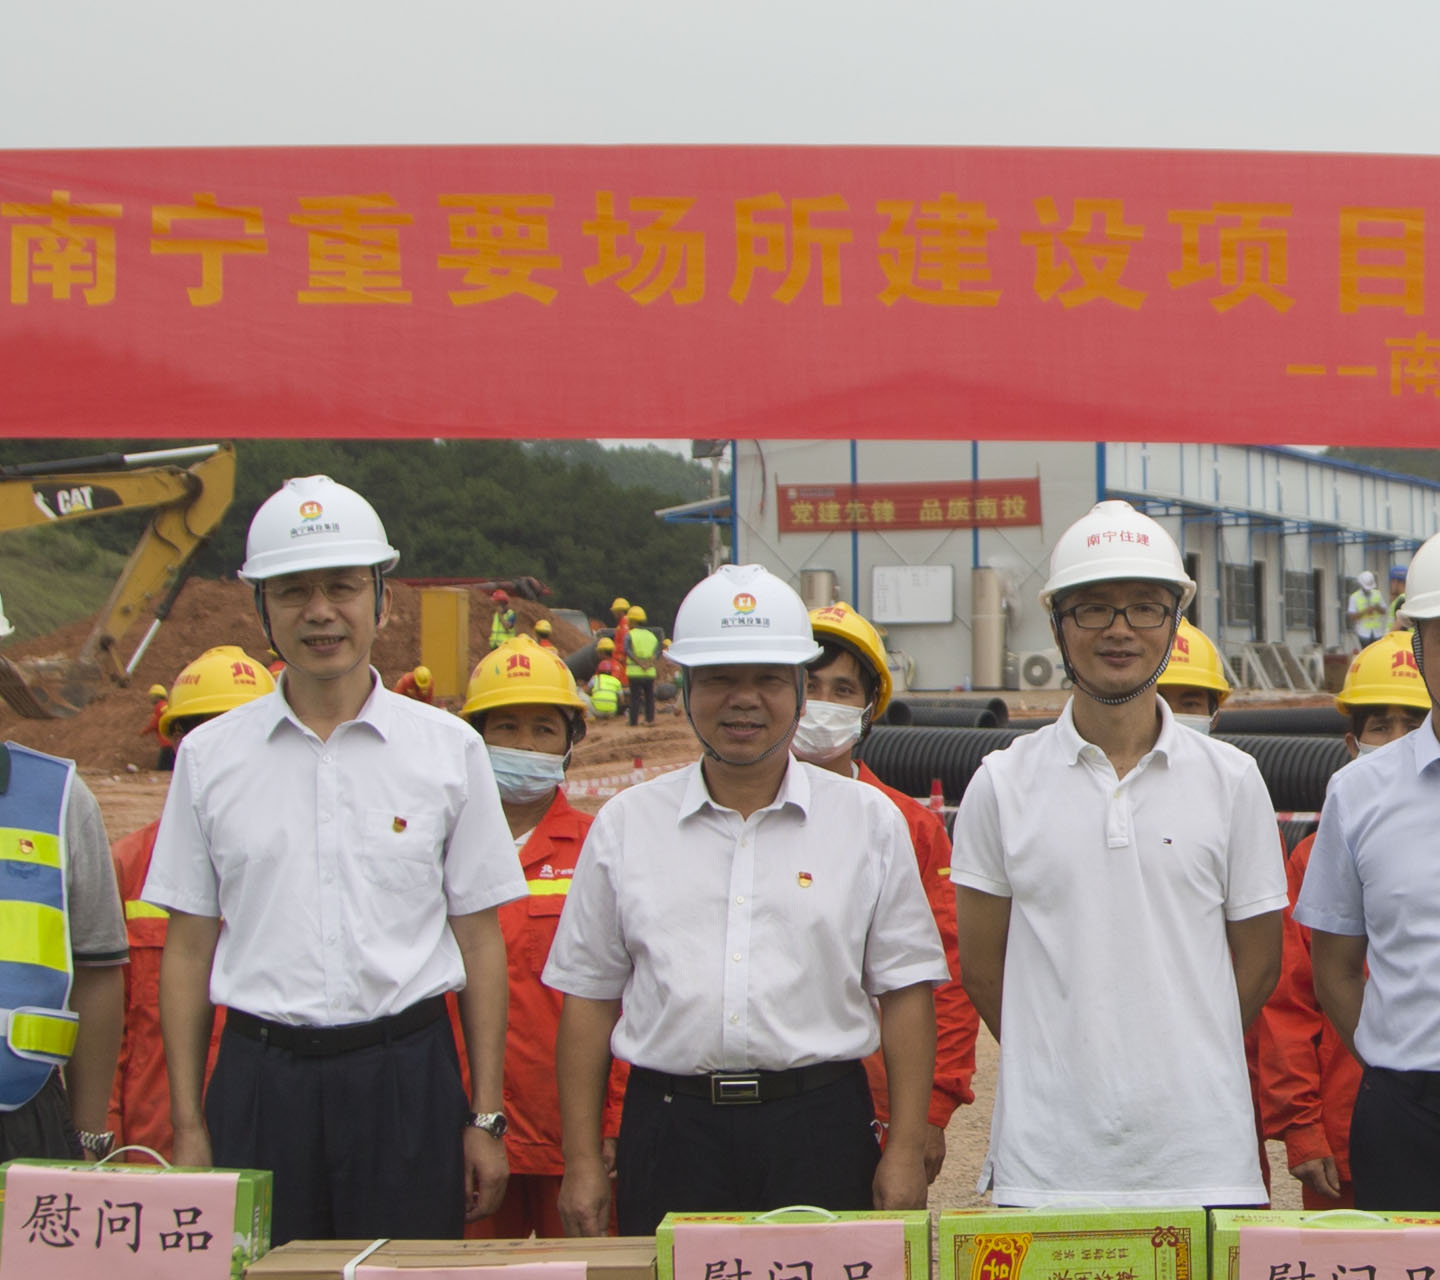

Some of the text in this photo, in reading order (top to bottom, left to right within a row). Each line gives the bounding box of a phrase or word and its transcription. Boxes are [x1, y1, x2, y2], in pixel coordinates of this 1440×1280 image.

[57, 486, 95, 513] CAT
[789, 497, 1028, 524] 党建先锋 品质南投
[1086, 530, 1151, 548] 南宁住建
[22, 1193, 213, 1253] 慰问品
